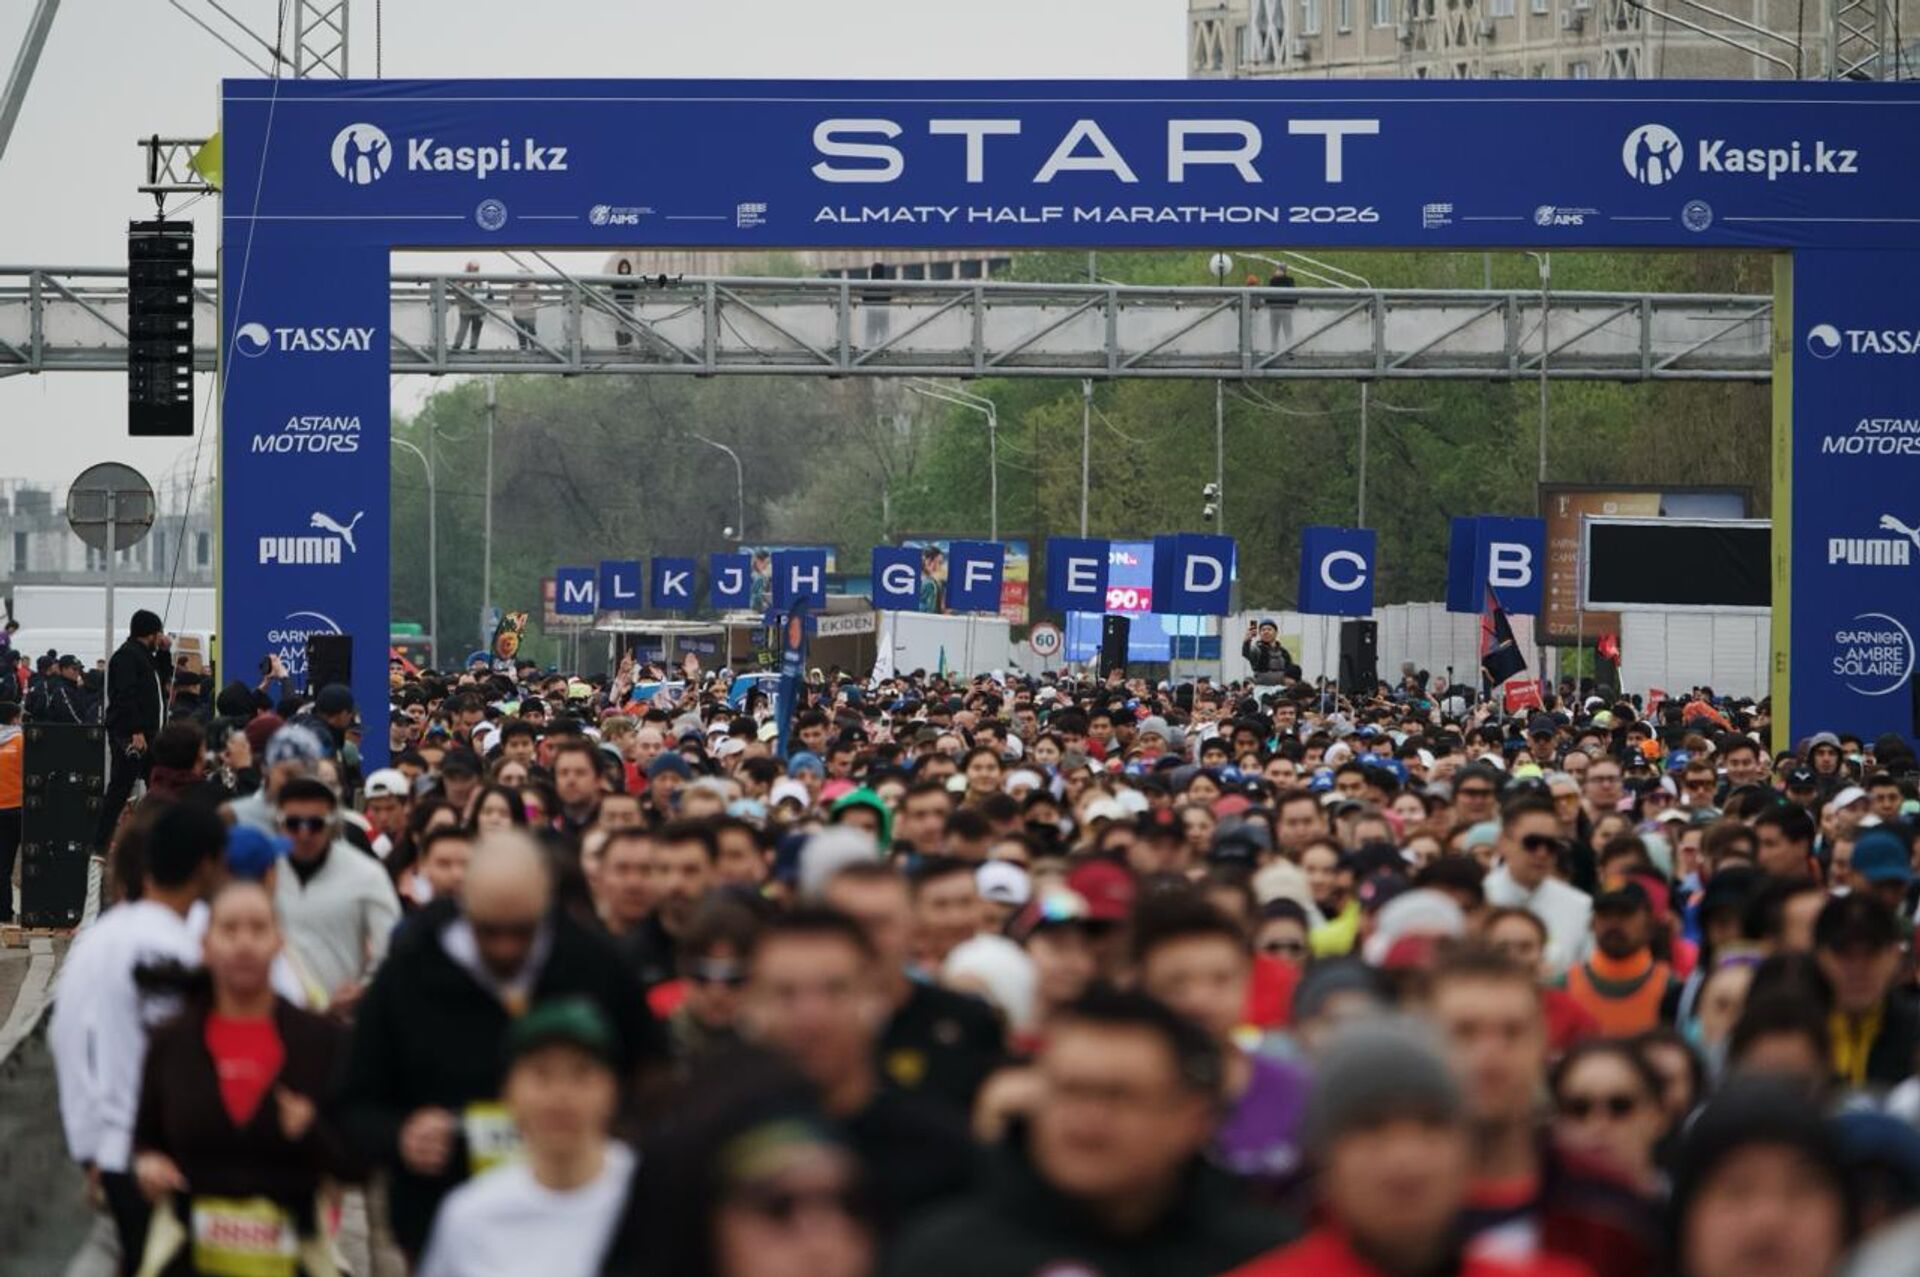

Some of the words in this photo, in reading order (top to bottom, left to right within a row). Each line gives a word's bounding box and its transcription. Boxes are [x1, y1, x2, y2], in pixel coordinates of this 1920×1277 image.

[408, 139, 568, 179] Kaspi.kz
[811, 118, 1380, 183] START
[1699, 139, 1859, 181] Kaspi.kz
[609, 214, 639, 225] AIMS
[814, 206, 959, 223] ALMATY
[968, 206, 1064, 223] HALF
[1073, 206, 1279, 223] MARATHON
[1288, 206, 1380, 223] 2026
[1553, 214, 1584, 225] AIMS
[274, 328, 375, 351] TASSAY
[285, 416, 361, 431] ASTANA
[1855, 418, 1920, 433] ASTAN
[252, 433, 360, 453] MOTORS
[259, 537, 341, 564] PUMA
[1828, 538, 1910, 566] PUMA
[964, 560, 994, 591] F
[1067, 558, 1099, 593] E
[1184, 555, 1223, 593] D
[1320, 550, 1367, 592] C
[1489, 543, 1532, 588] B
[564, 580, 593, 603] M
[614, 574, 636, 598] L
[663, 570, 689, 596] K
[718, 568, 743, 594] J
[791, 566, 819, 593] H
[882, 563, 915, 595] G
[821, 617, 873, 632] EKIDEN
[1036, 633, 1055, 647] 60
[1845, 646, 1904, 662] AMBRE
[1832, 658, 1904, 677] SOLAIRE
